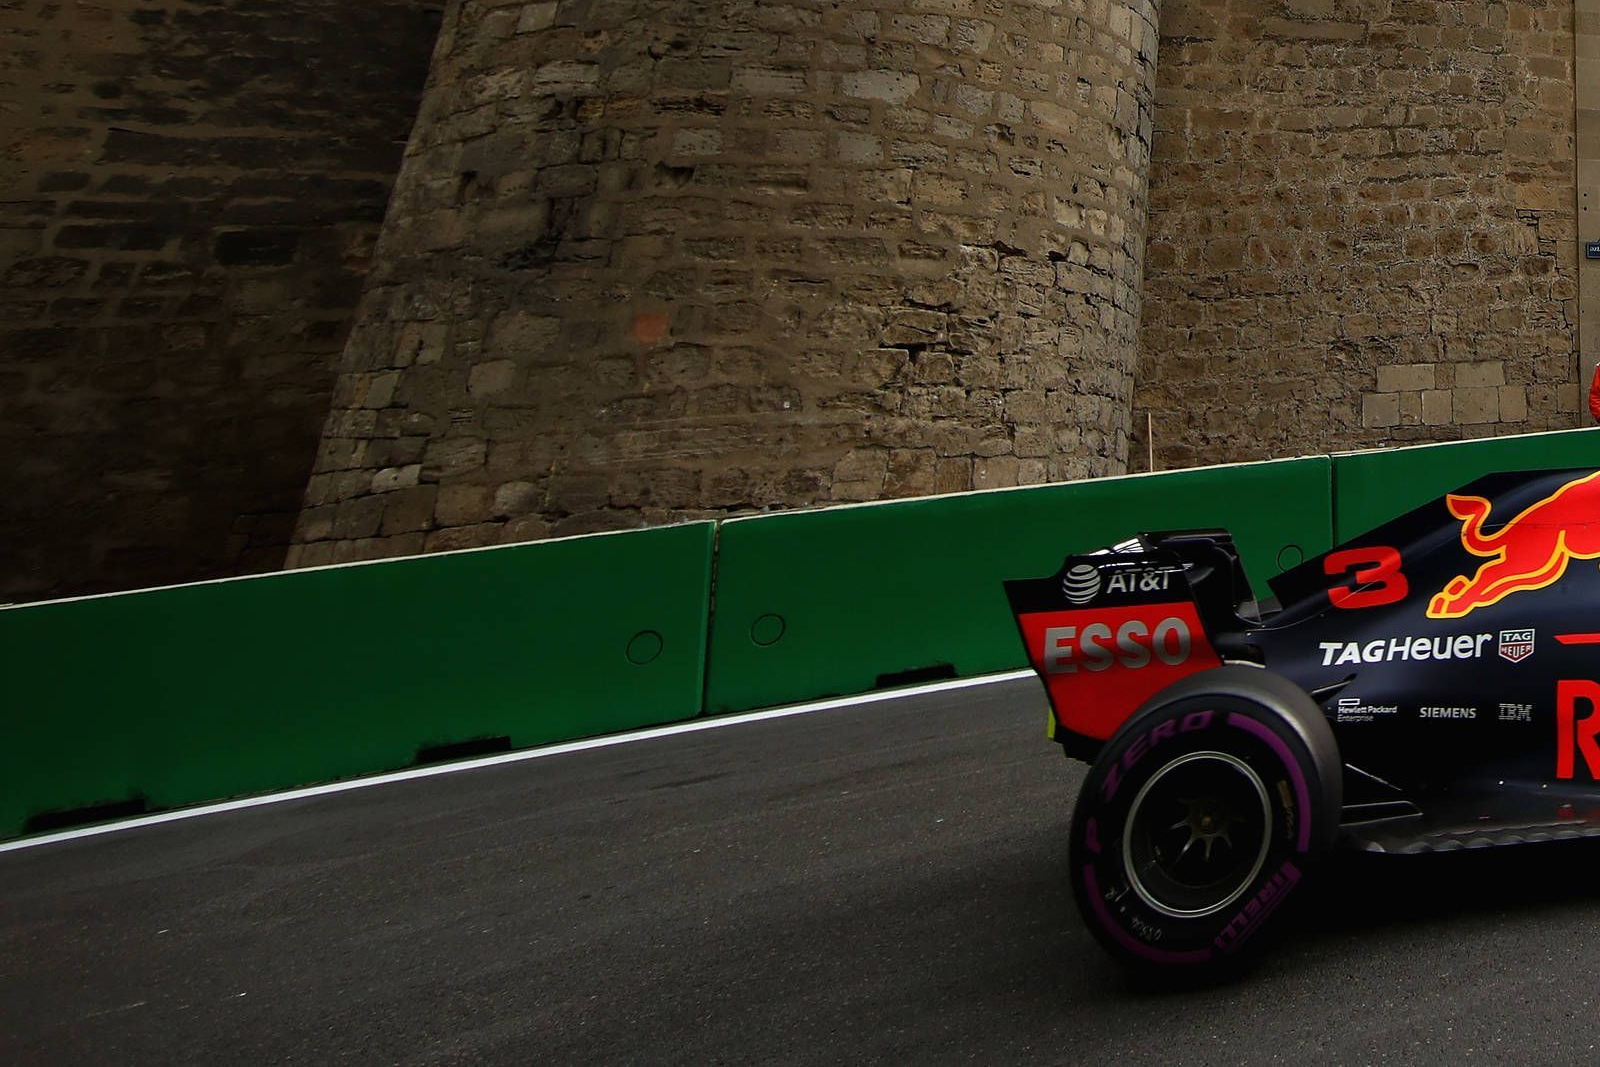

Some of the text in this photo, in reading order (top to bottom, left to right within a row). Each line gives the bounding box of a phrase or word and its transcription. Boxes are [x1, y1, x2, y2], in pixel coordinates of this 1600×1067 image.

[1106, 565, 1176, 594] AT&T
[1323, 546, 1409, 610] 3
[1044, 617, 1192, 674] ESSO
[1503, 632, 1532, 642] TAG
[1501, 645, 1533, 659] HEUER
[1419, 706, 1477, 719] SIEMENS
[1498, 703, 1533, 722] IBM
[1100, 709, 1217, 805] ZERO
